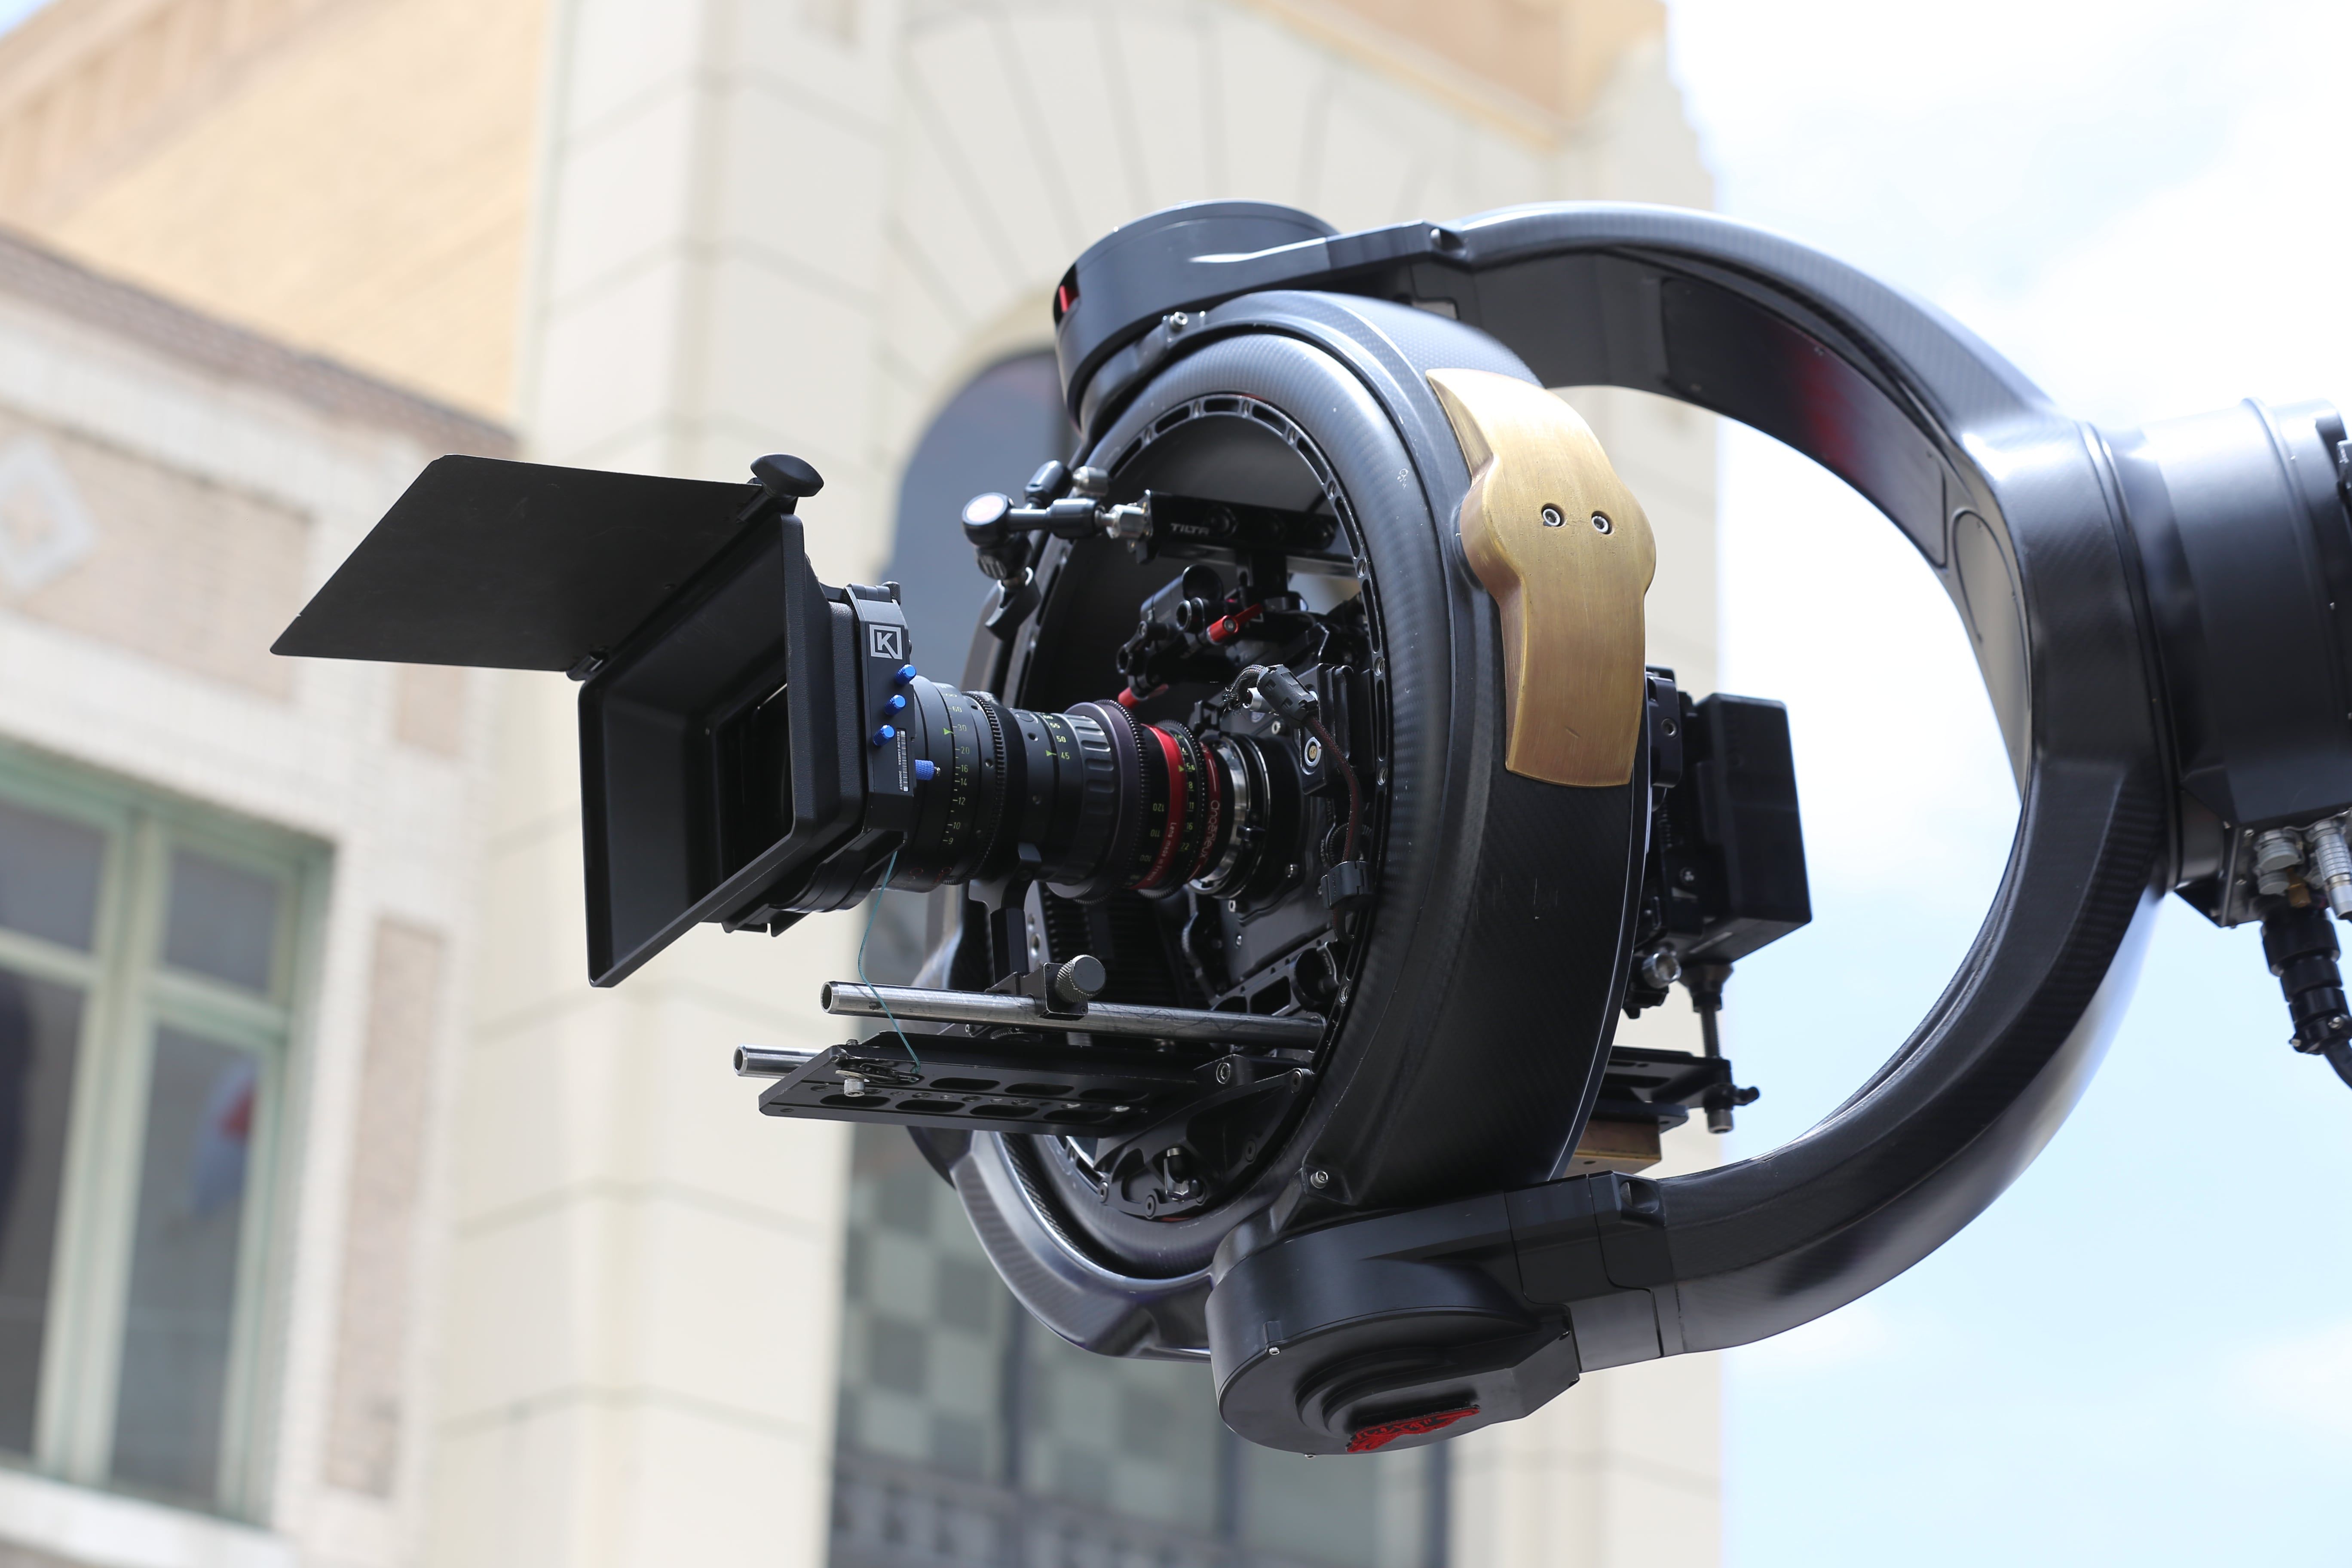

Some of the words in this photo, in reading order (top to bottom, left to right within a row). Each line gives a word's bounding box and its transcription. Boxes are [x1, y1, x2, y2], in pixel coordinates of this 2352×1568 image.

[961, 746, 970, 754] 20
[961, 764, 968, 773] 16
[960, 778, 967, 786] 14
[1188, 781, 1193, 789] 8
[958, 797, 966, 805] 12
[1152, 802, 1165, 812] 120
[1189, 802, 1194, 810] 11
[1150, 829, 1161, 838] 110
[1167, 822, 1177, 838] Lens
[1180, 842, 1190, 850] 22
